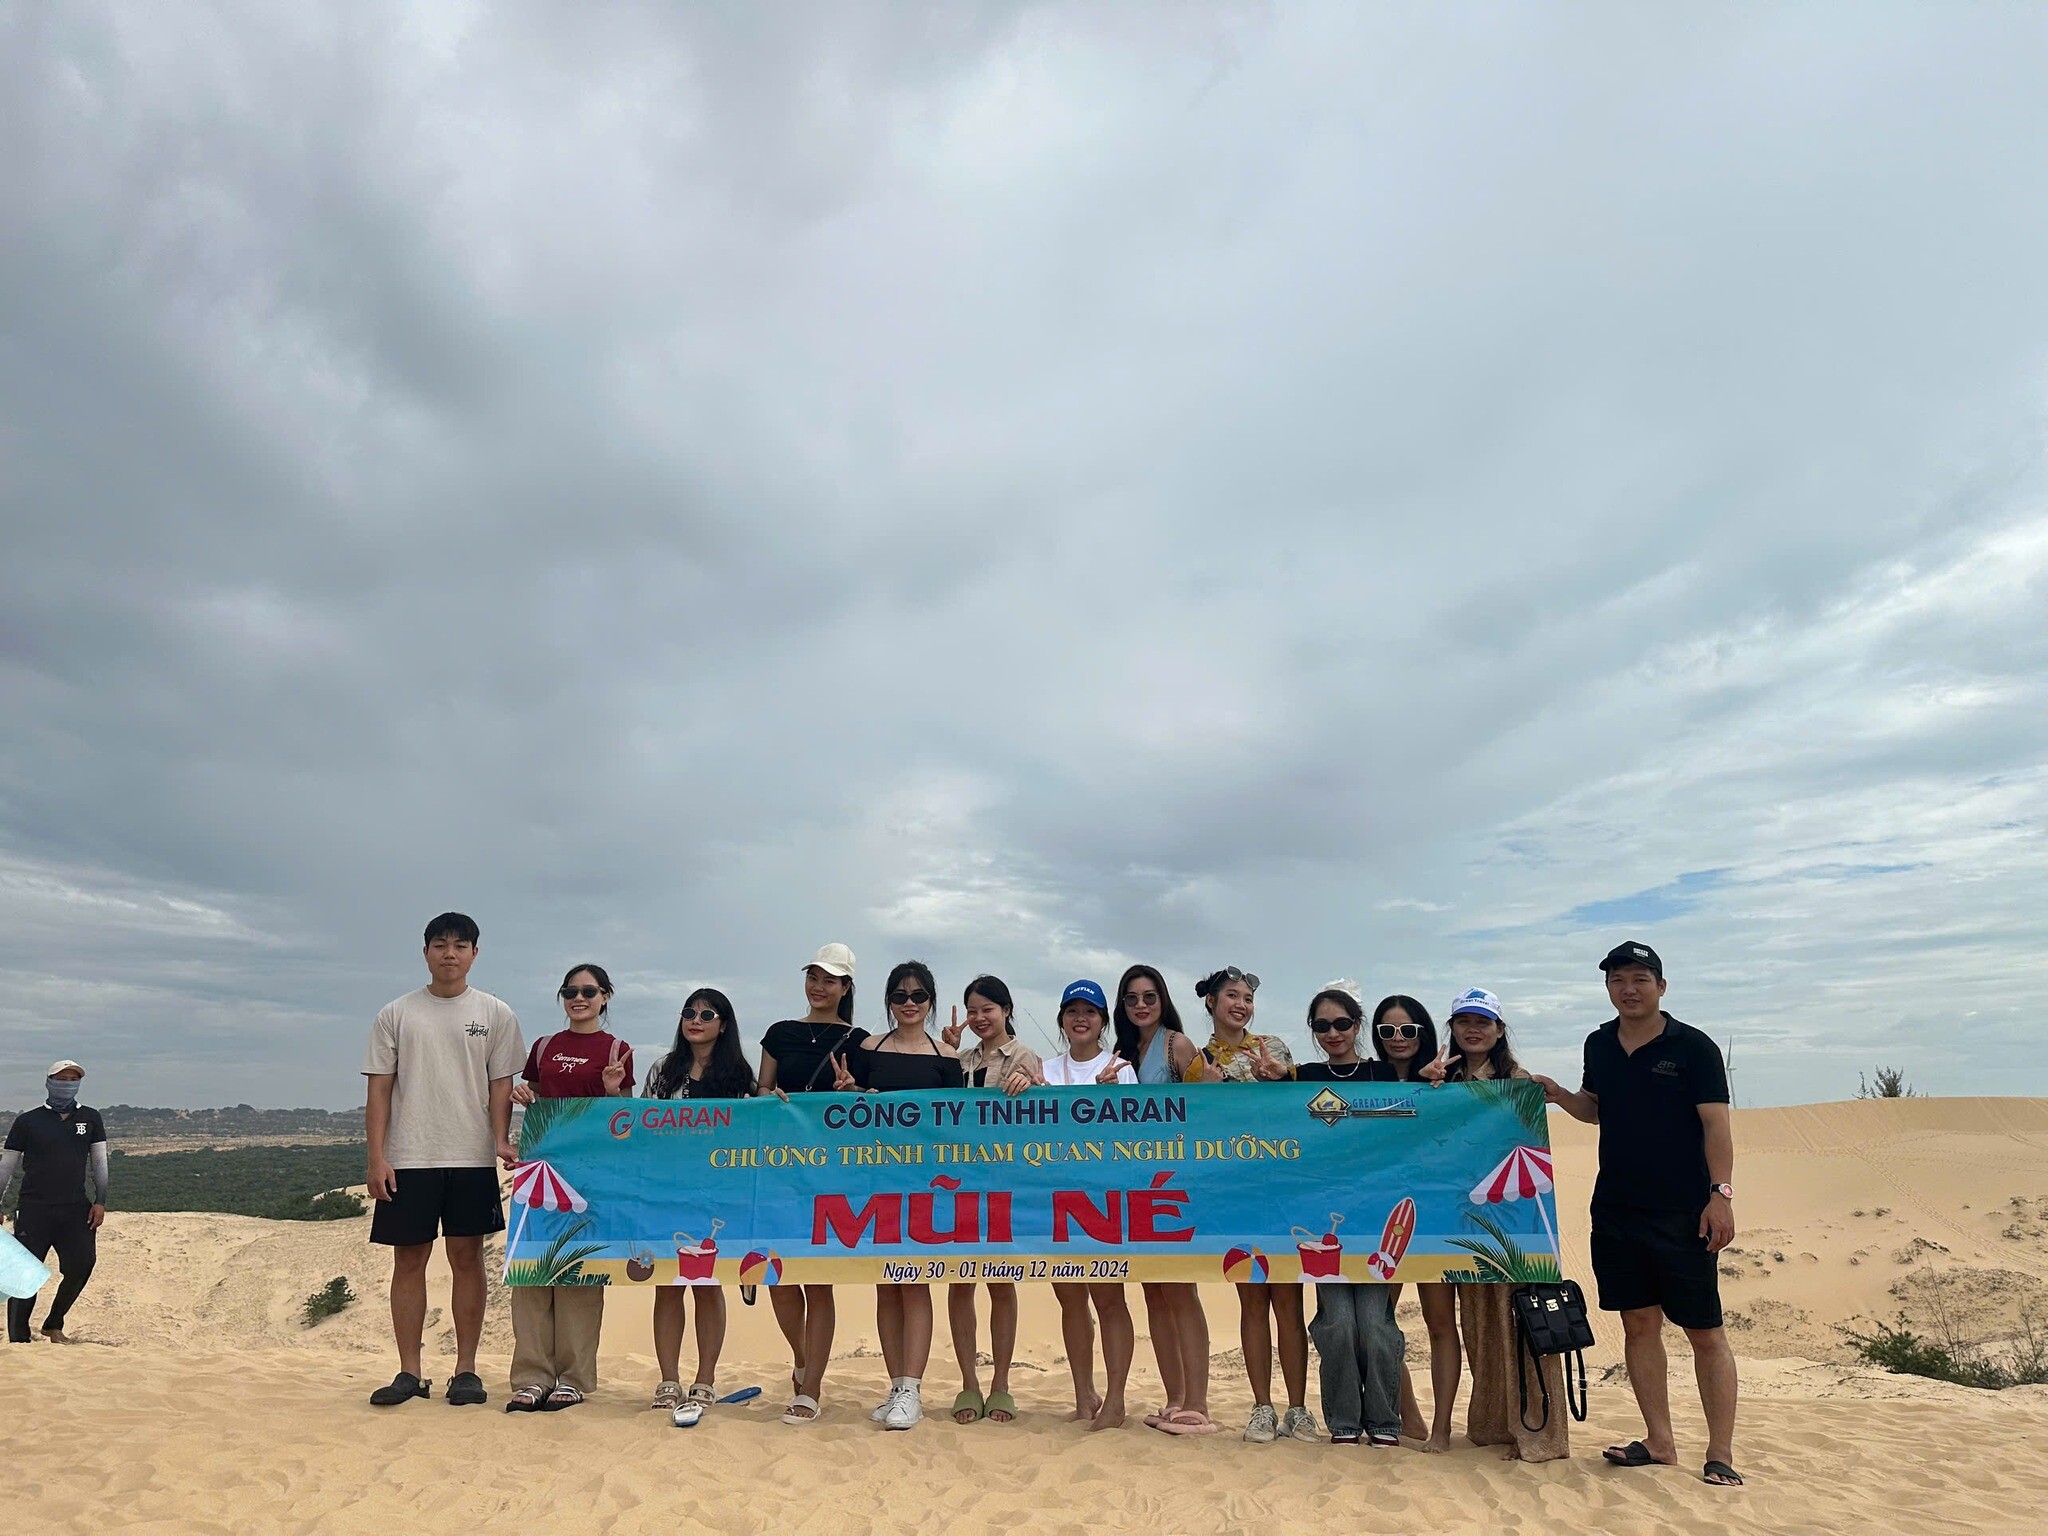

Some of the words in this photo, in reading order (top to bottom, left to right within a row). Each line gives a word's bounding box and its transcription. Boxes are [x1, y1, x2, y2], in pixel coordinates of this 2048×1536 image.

[824, 1096, 921, 1129] CÔNG
[931, 1101, 965, 1126] TY
[975, 1099, 1059, 1125] TNHH
[1070, 1097, 1187, 1123] GARAN
[1352, 1098, 1380, 1108] GREAT
[1382, 1097, 1416, 1108] TRAVEL
[641, 1106, 731, 1129] GARAN
[709, 1145, 828, 1168] CHƯƠNG
[836, 1139, 924, 1166] TRÌNH
[933, 1142, 1014, 1164] THAM
[1022, 1141, 1104, 1167] QUAN
[1112, 1133, 1186, 1161] NGHỈ
[1194, 1133, 1301, 1161] DƯỠNG
[811, 1174, 1013, 1249] MŨI
[1052, 1171, 1197, 1245] NÉ
[883, 1262, 922, 1282] Ngày
[926, 1261, 945, 1278] 30
[960, 1261, 977, 1278] 01
[982, 1261, 1024, 1281] tháng
[1029, 1260, 1047, 1277] 12
[1051, 1261, 1085, 1277] năm
[1089, 1260, 1129, 1277] 2024
